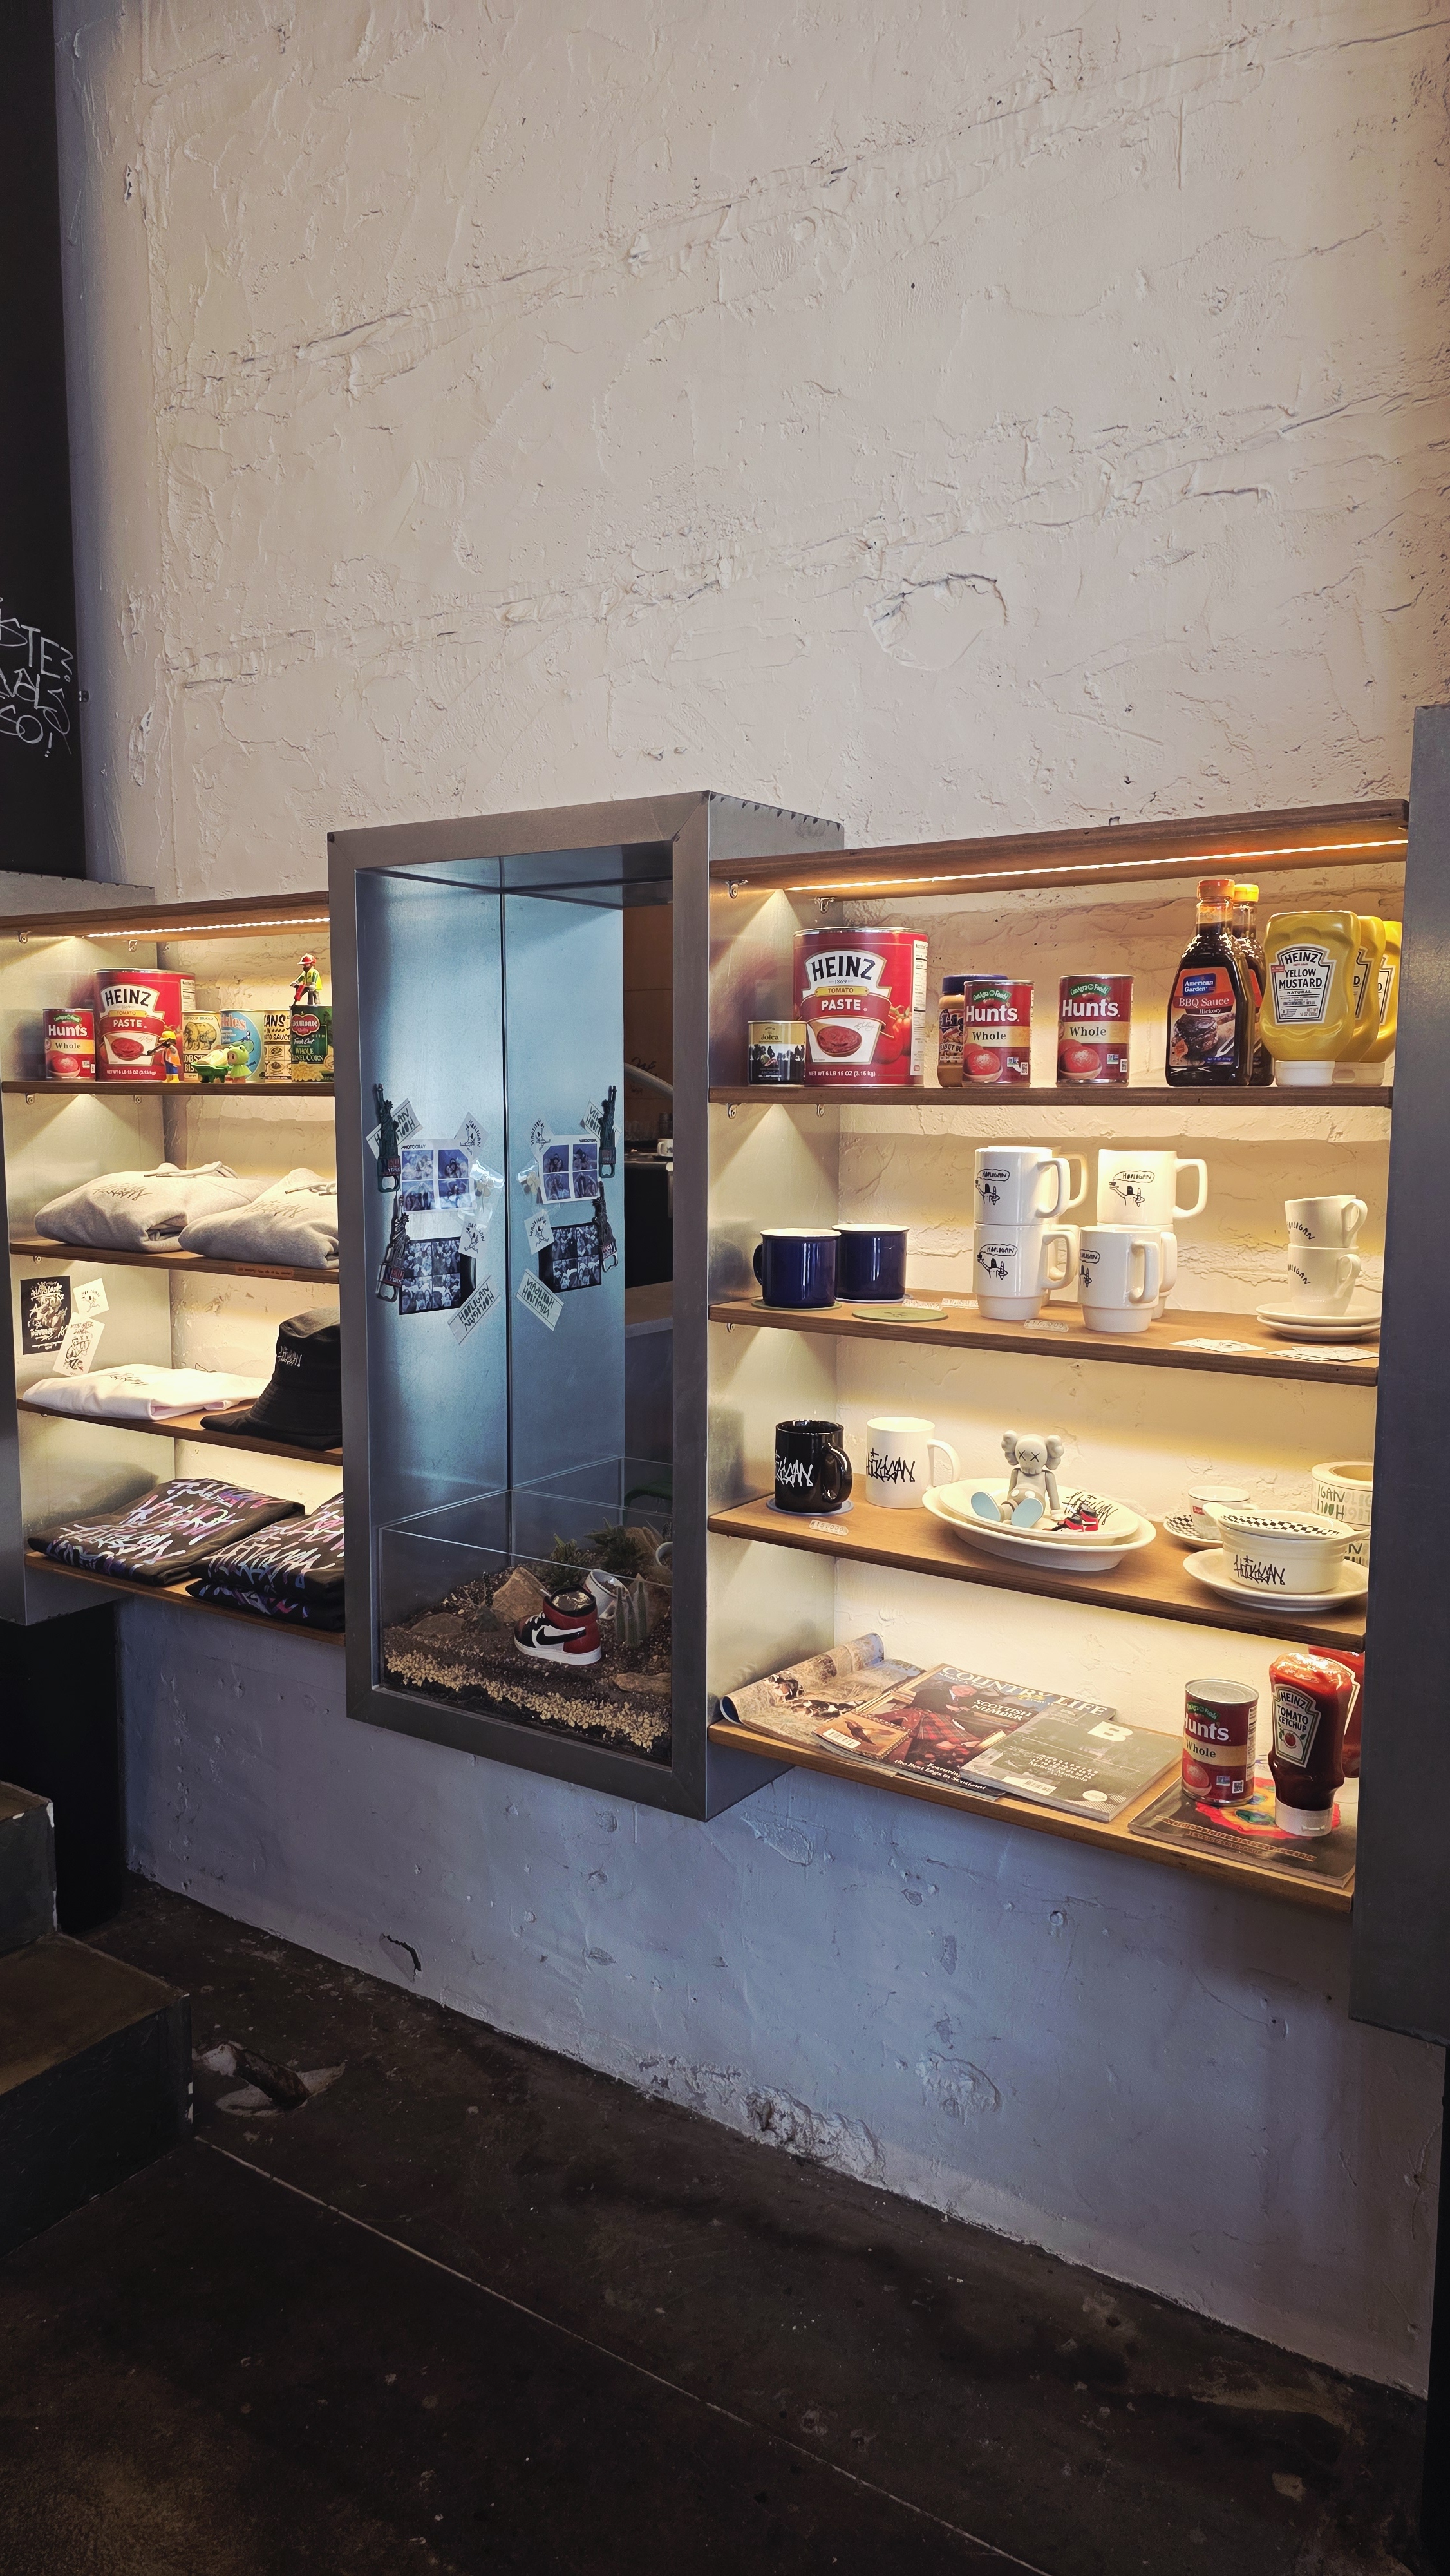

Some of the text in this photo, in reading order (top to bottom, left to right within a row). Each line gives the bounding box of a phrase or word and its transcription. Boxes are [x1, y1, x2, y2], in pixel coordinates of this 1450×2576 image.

[1284, 952, 1319, 965] HEINZ
[811, 956, 876, 981] HEINZ
[1285, 969, 1317, 978] YELLOW
[1094, 984, 1108, 994] Foods
[1279, 978, 1322, 989] MUSTARD
[104, 989, 151, 1007] HEINZ
[995, 990, 1009, 1000] Foods
[822, 999, 862, 1011] PASTE
[1179, 998, 1229, 1008] BBQ Sauce
[113, 1019, 142, 1028] PASTE
[972, 1031, 1006, 1041] Whole
[1069, 1027, 1107, 1037] Whole
[295, 1047, 314, 1056] WHOLE
[467, 1119, 481, 1148] HOOLIGAN
[458, 1283, 491, 1324] HOOLIGAN
[942, 1667, 1107, 1716] COUNTRY LIFE
[1281, 1692, 1306, 1709] HEINZ
[971, 1704, 1023, 1721] NUMBER
[974, 1700, 1033, 1717] SCOTTISH
[1204, 1708, 1218, 1719] Foods
[1277, 1704, 1309, 1725] TOMATO
[1278, 1714, 1307, 1732] KETCHUP
[1088, 1721, 1133, 1742] B
[1185, 1739, 1216, 1758] Whole
[925, 1766, 942, 1776] Legs
[927, 1763, 961, 1778] Featuring
